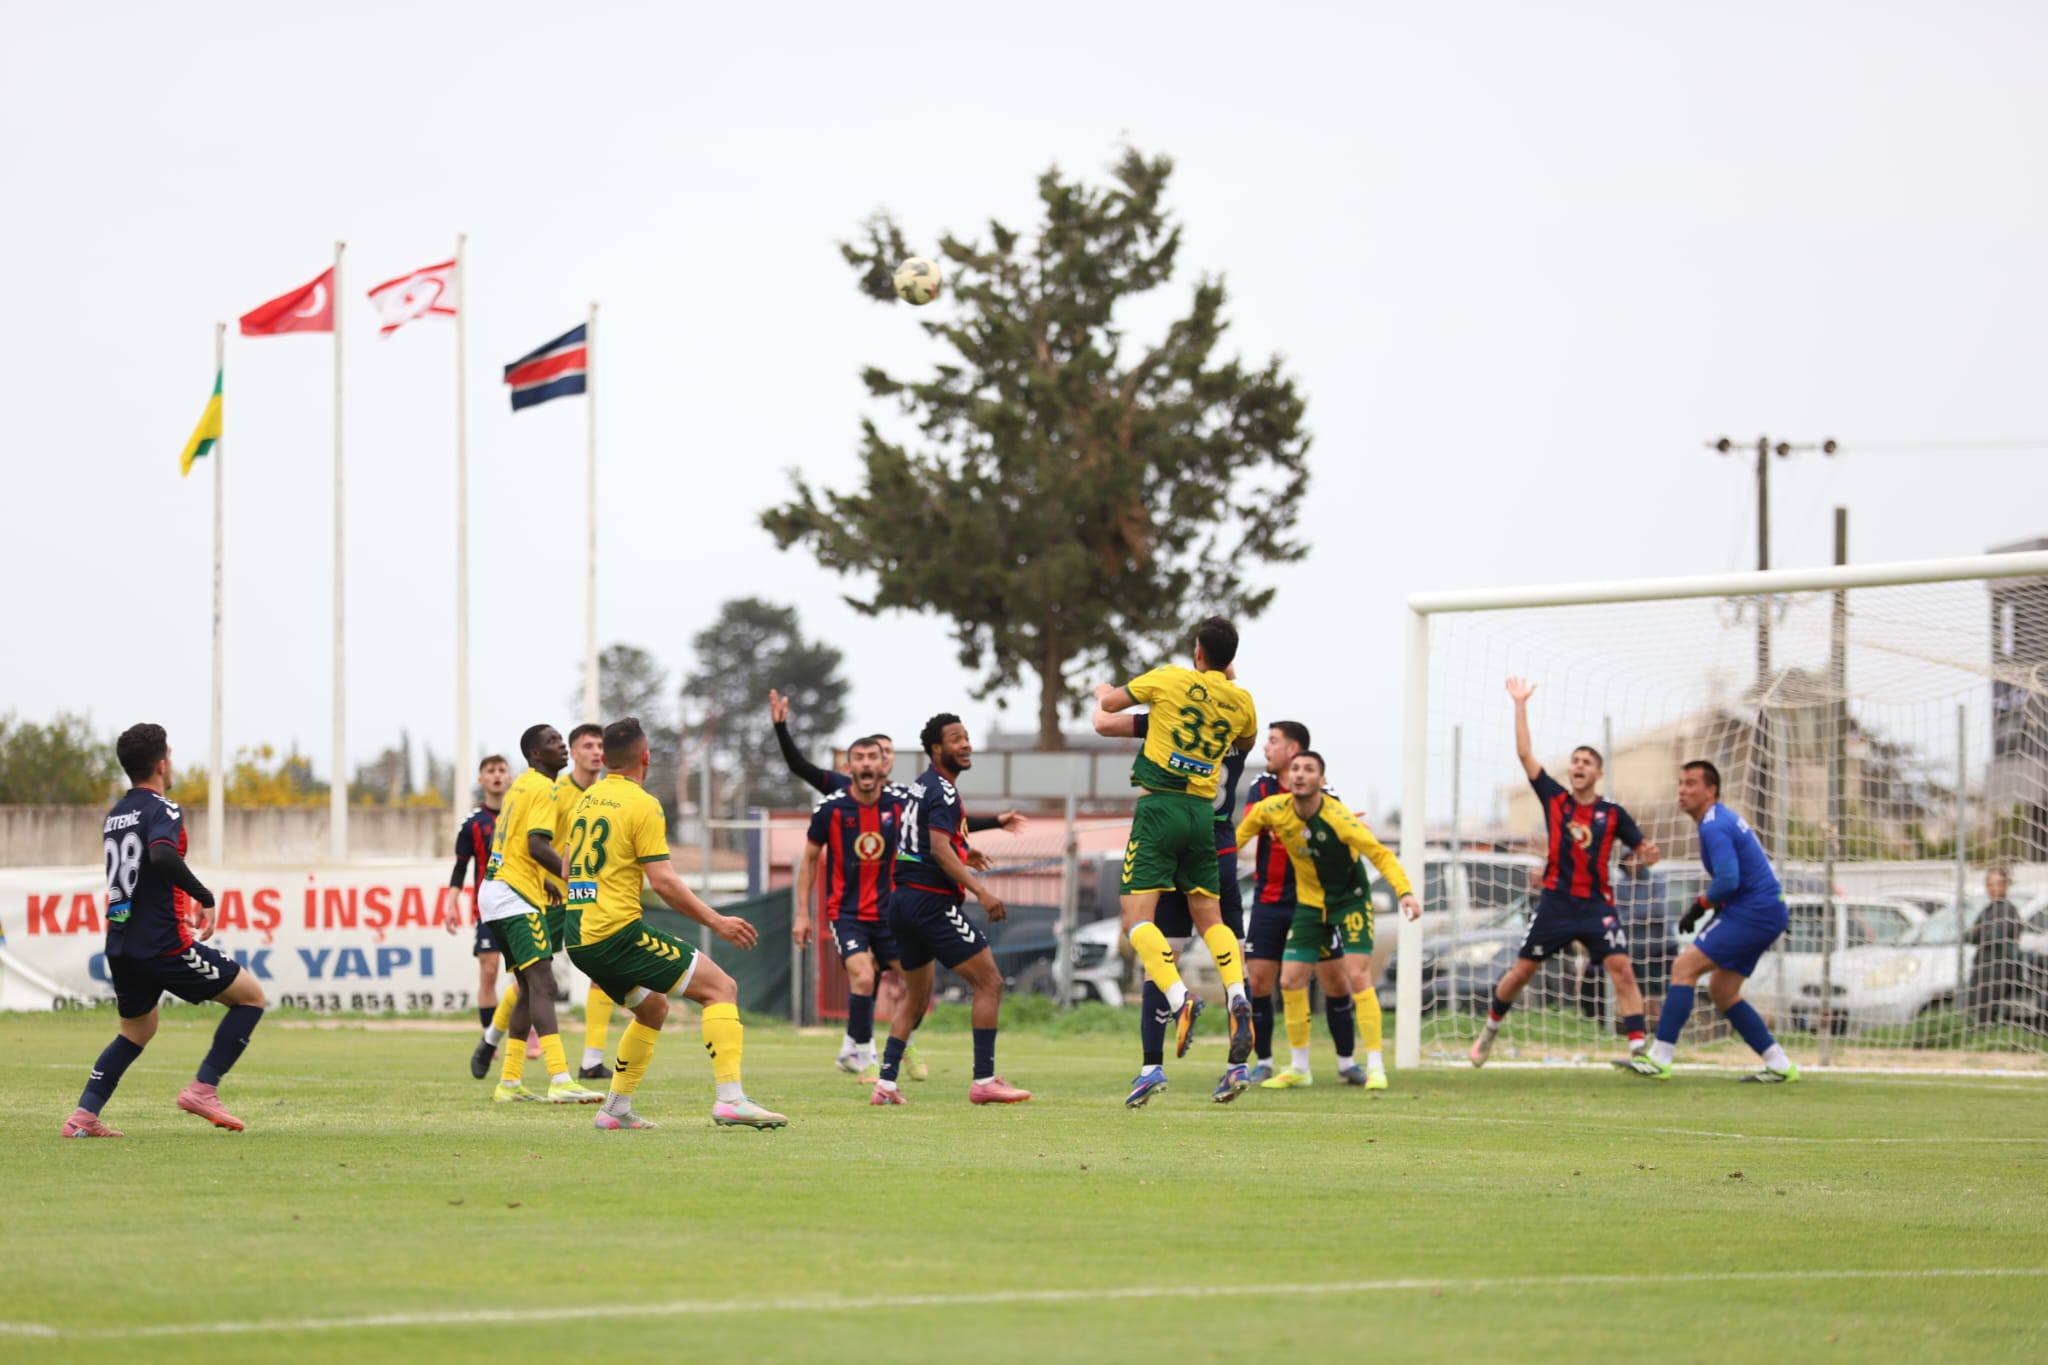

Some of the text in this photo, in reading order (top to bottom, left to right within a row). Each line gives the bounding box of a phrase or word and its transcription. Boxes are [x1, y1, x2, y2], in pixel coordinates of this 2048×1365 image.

[1172, 706, 1231, 760] 33
[104, 831, 142, 902] 28
[569, 816, 611, 878] 23
[296, 946, 435, 979] YAPI
[443, 991, 470, 1009] 27
